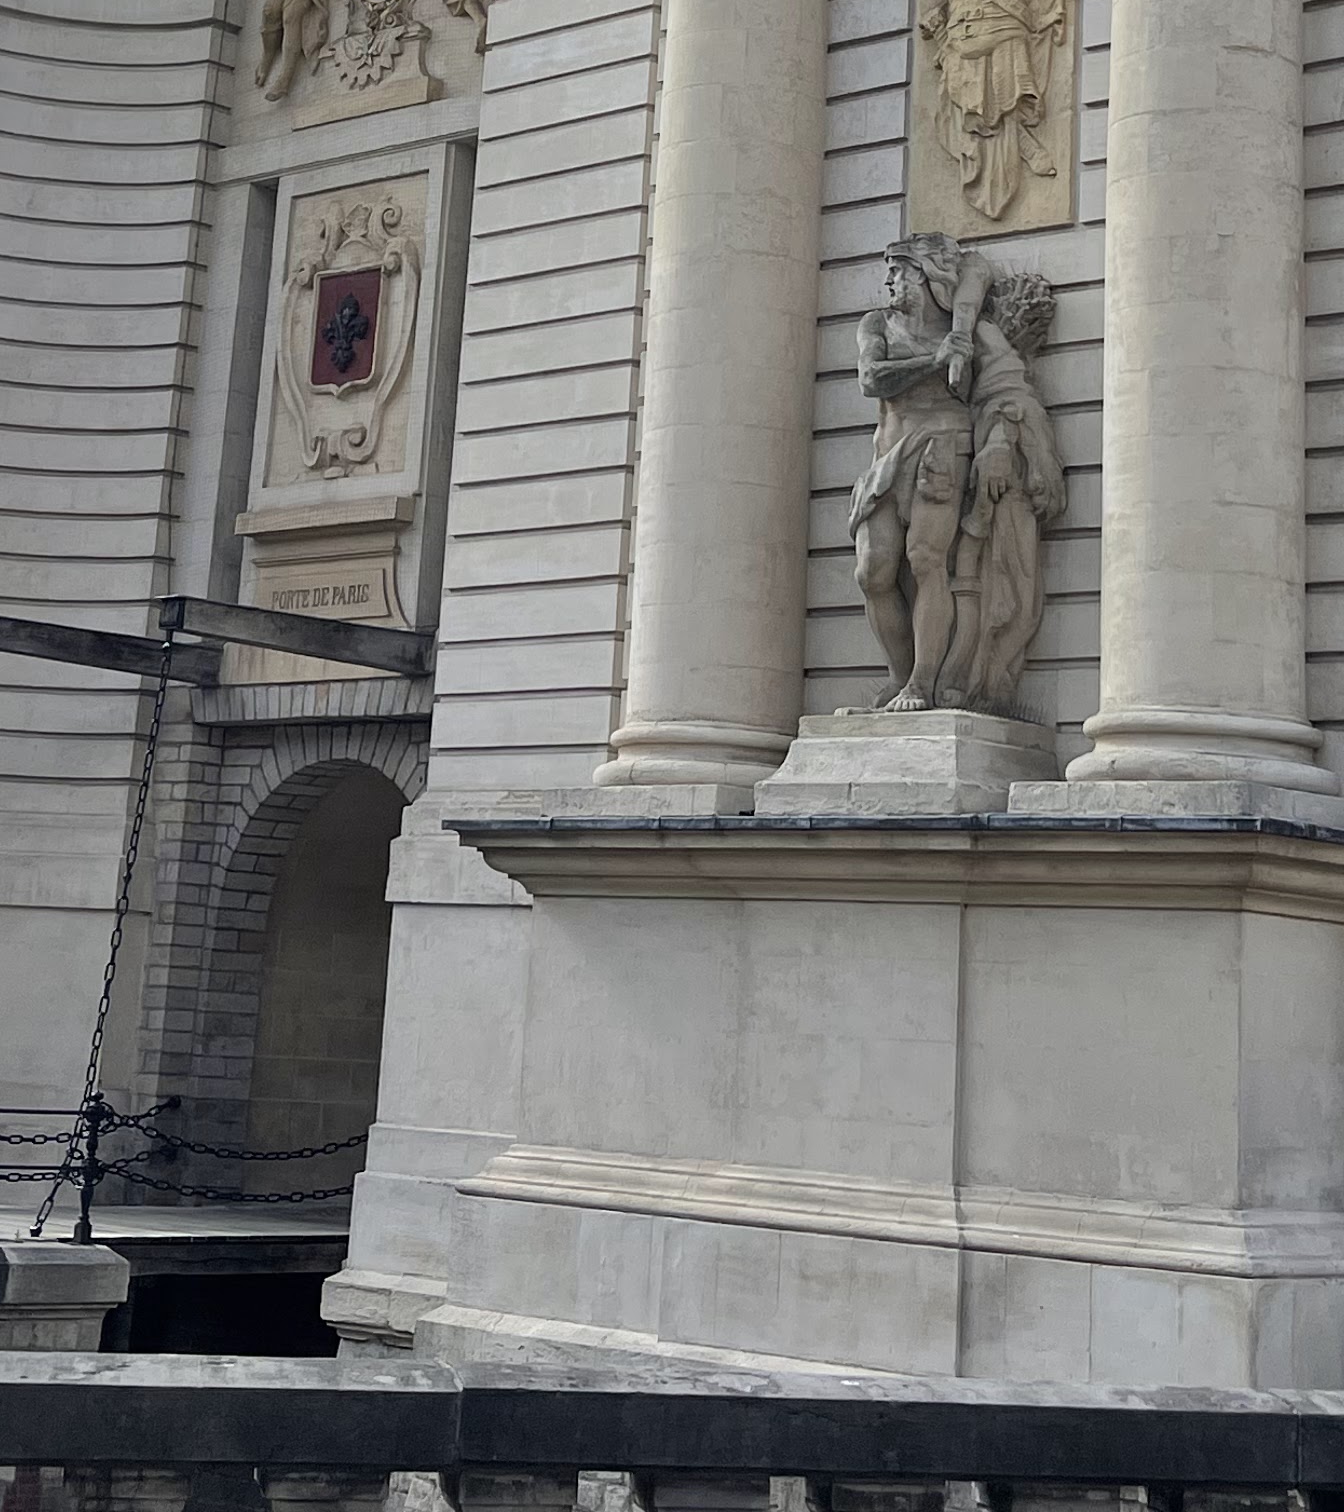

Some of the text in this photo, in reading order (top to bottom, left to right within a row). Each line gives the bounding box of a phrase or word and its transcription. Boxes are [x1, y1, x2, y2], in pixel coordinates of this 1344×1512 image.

[271, 584, 370, 610] PORTE DE PARIS
